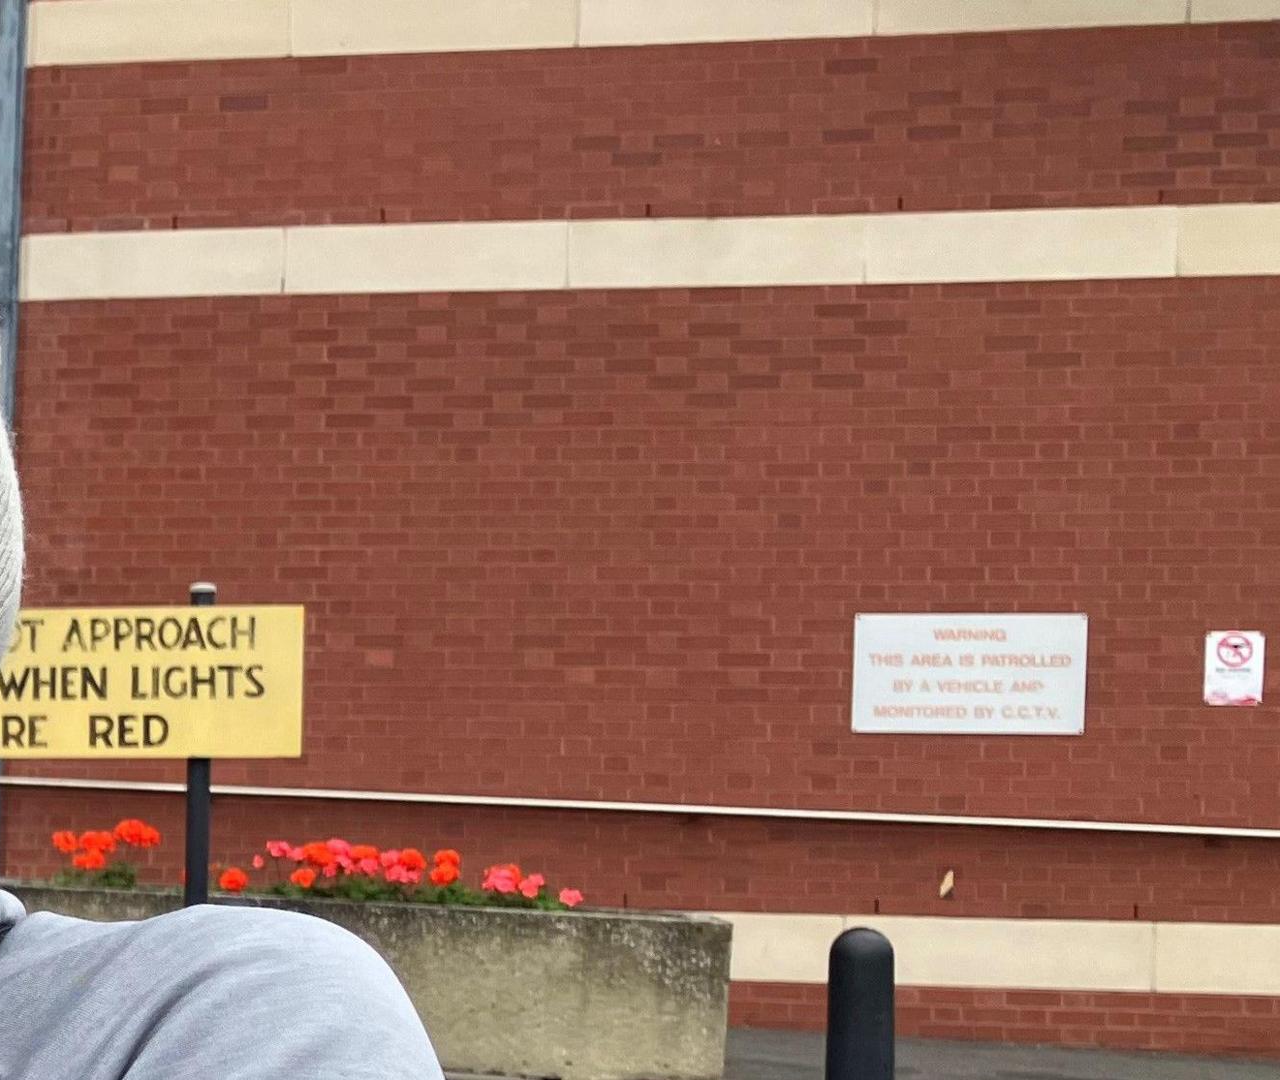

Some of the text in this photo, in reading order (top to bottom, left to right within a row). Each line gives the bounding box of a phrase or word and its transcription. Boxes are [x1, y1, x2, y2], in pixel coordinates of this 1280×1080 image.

[62, 616, 256, 652] APPROACH
[933, 628, 1007, 641] WARNING
[869, 653, 1072, 668] THIS AREA IS PATROLLED
[130, 665, 265, 700] LIGHTS
[893, 679, 913, 693] BY
[920, 680, 930, 693] A
[937, 679, 1003, 694] VEHICLE
[873, 704, 967, 718] MONITORED
[974, 704, 994, 718] BY
[88, 714, 169, 748] RED
